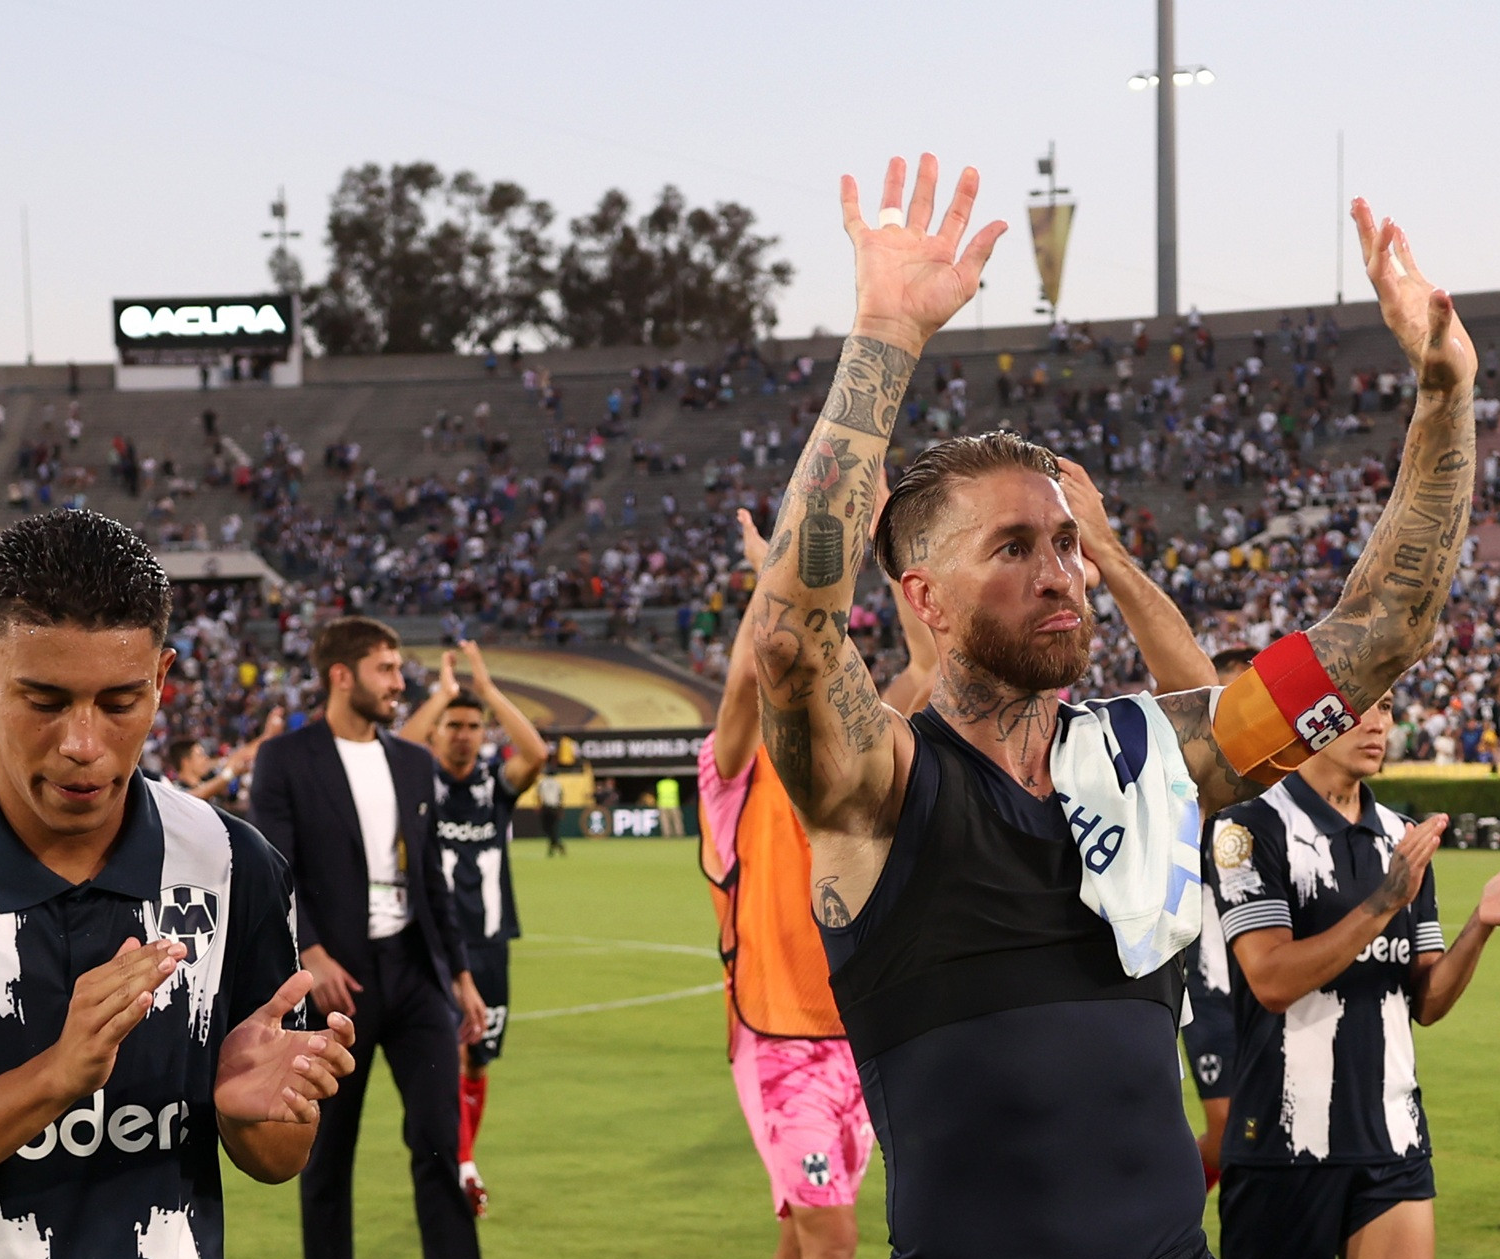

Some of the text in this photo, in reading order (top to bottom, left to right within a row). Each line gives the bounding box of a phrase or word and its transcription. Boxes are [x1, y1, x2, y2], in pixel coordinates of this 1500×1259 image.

[151, 304, 287, 336] ACURA
[627, 738, 689, 758] WORLD
[612, 808, 660, 837] PIF
[1057, 792, 1126, 876] BH
[16, 1088, 190, 1160] oder
